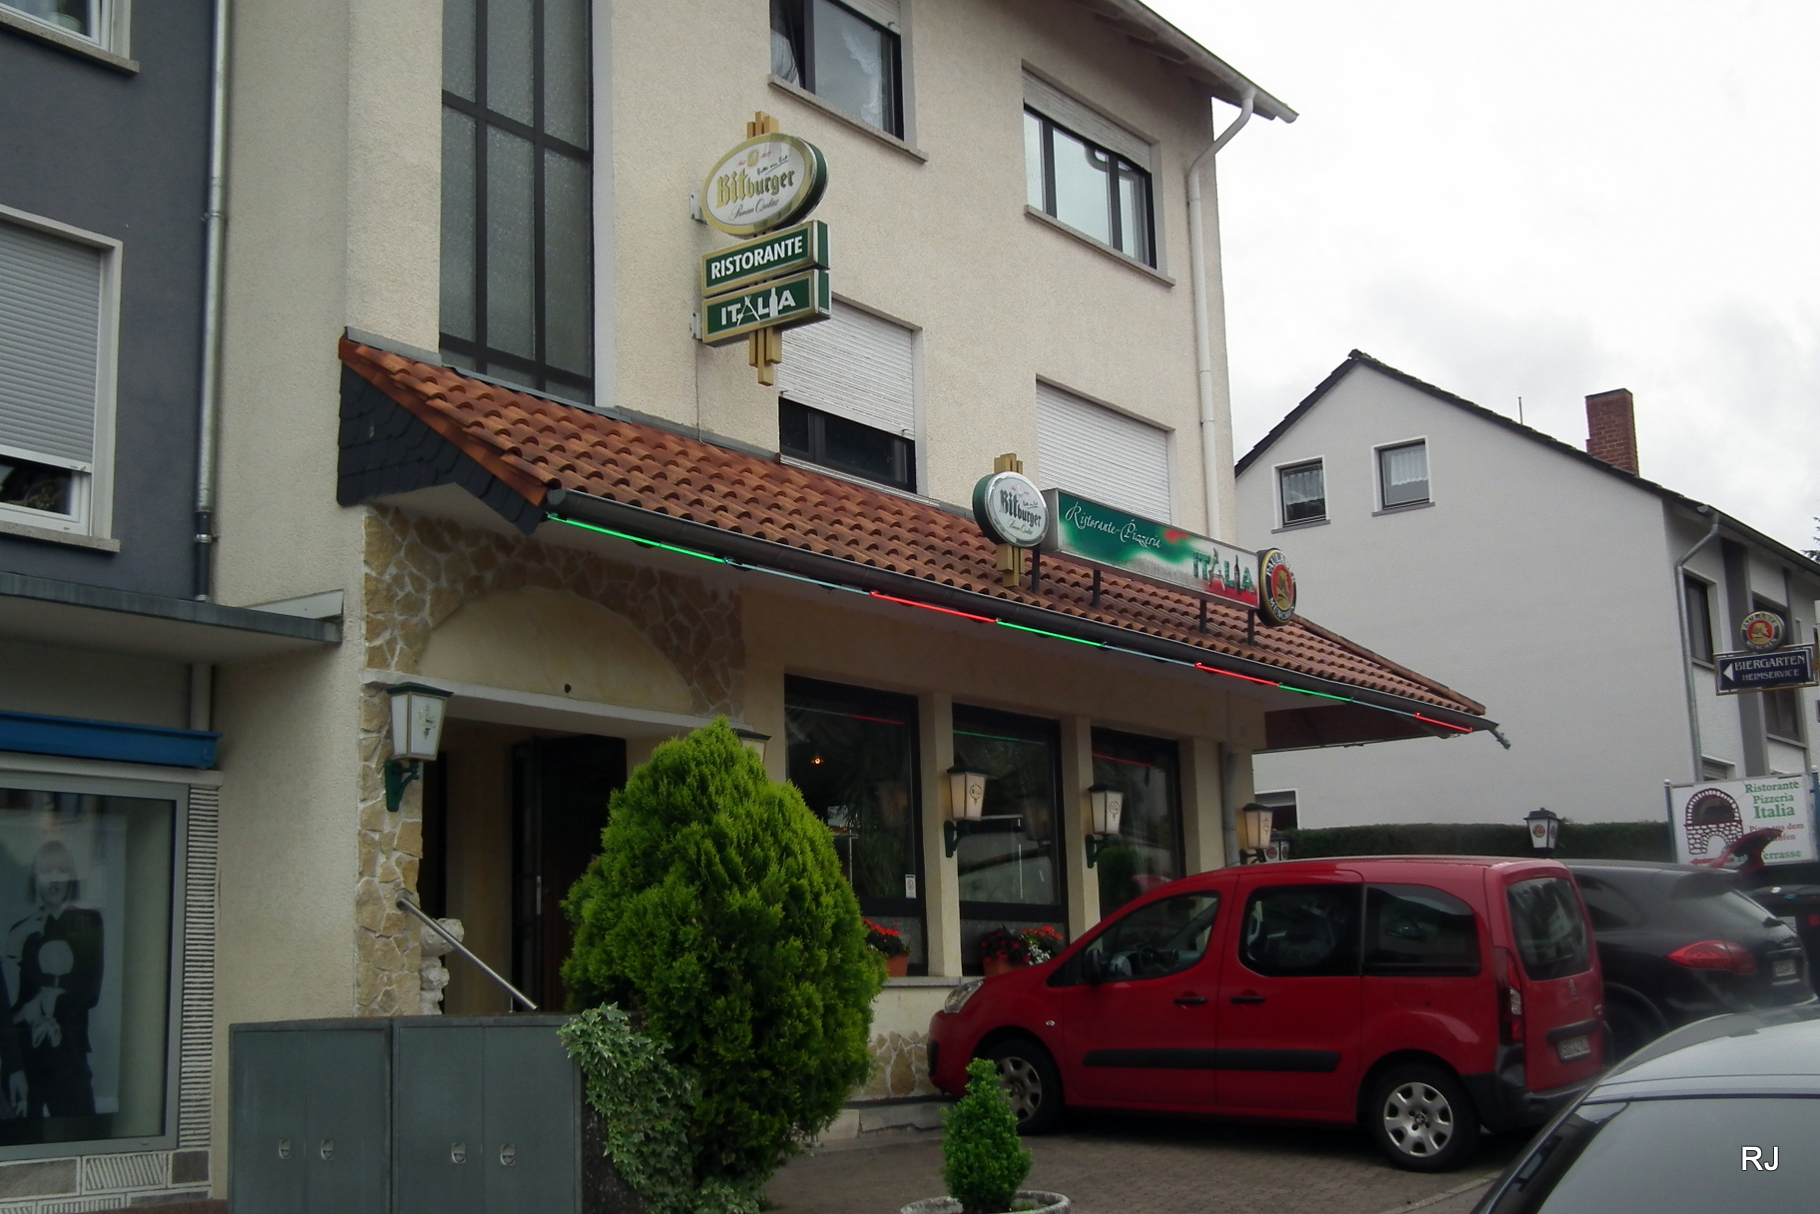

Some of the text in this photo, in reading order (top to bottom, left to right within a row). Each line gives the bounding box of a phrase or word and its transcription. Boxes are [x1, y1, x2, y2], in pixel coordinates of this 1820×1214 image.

[716, 168, 795, 208] Bitburger
[711, 236, 803, 280] RISTORANTE
[999, 489, 1042, 528] Bitburger
[1734, 655, 1806, 671] BIERGARTEN
[1742, 669, 1799, 681] HEIMSERVICE
[1745, 781, 1800, 793] Ristorante
[1753, 793, 1794, 804] Pizzeria
[1754, 803, 1795, 819] Italia
[1787, 822, 1804, 830] dem
[1762, 850, 1802, 860] errasse
